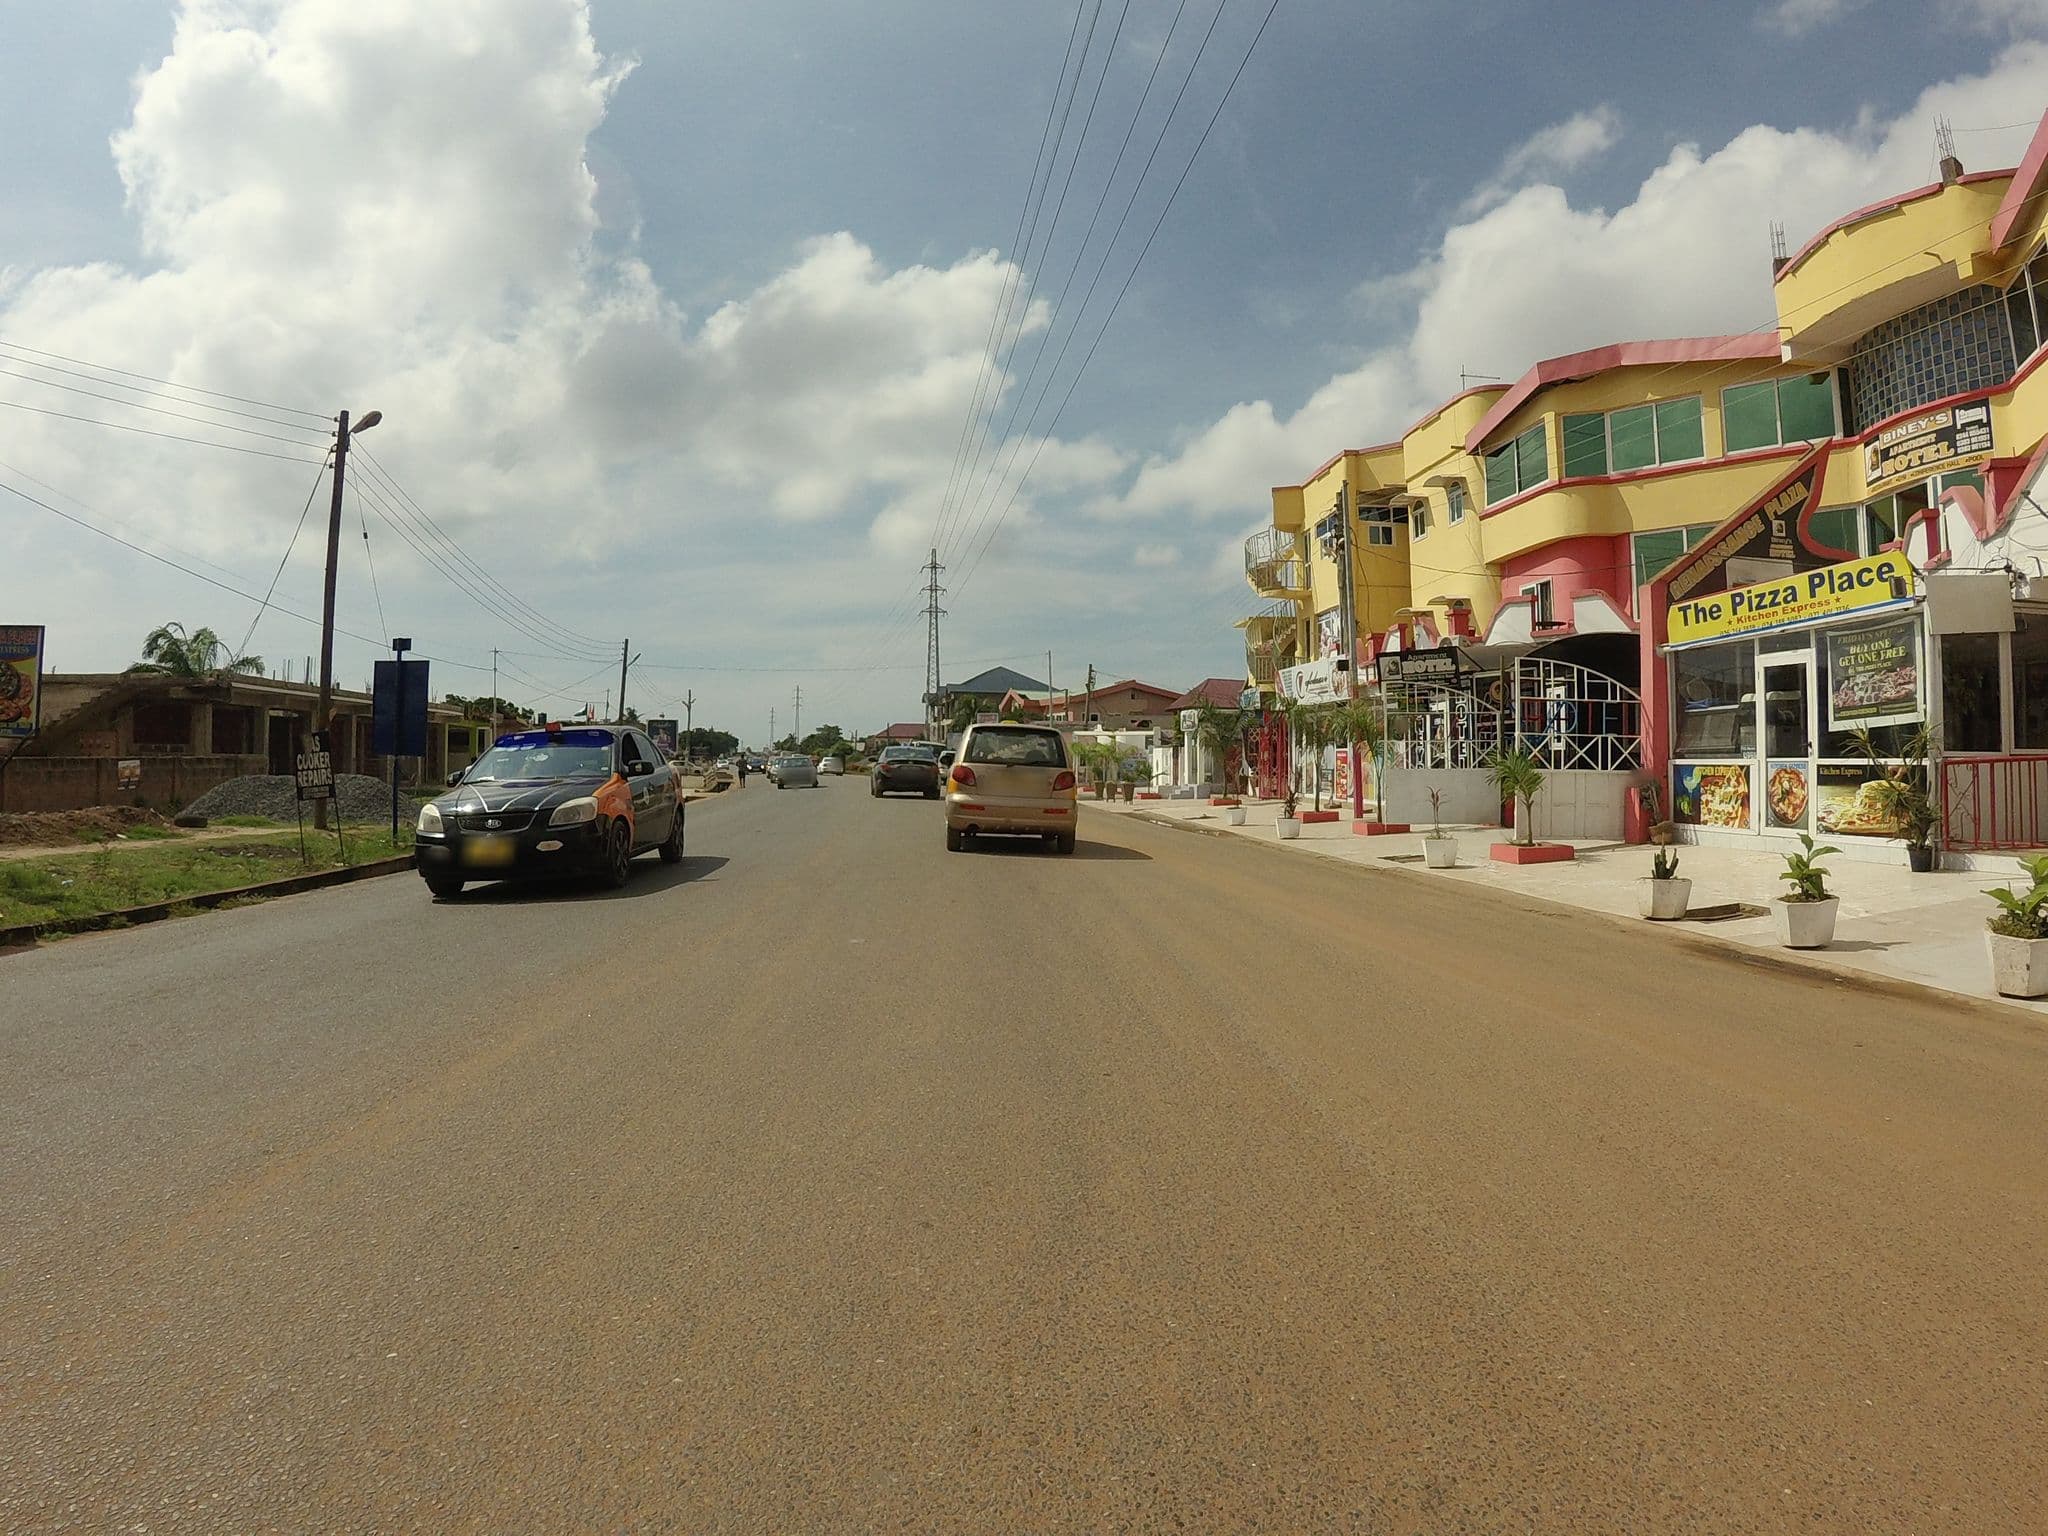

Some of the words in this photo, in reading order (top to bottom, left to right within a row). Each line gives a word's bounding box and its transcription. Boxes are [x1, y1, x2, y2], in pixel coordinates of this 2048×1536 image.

[1883, 412, 1948, 443] BINEY'S
[1882, 442, 1955, 477] HOTEL
[1669, 514, 1766, 600] RENAISSANCE
[1764, 481, 1810, 520] PLAZA
[1677, 602, 1722, 627] The
[1730, 585, 1798, 616] Pizza
[1808, 562, 1895, 599] Place
[1736, 610, 1779, 624] Kitchen
[1782, 599, 1831, 615] Express
[1839, 655, 1856, 667] GET
[1858, 651, 1878, 664] ONE
[1880, 646, 1906, 660] FREE
[1850, 643, 1868, 655] BUY
[1870, 638, 1891, 651] ONE
[1402, 658, 1456, 674] HOTEL
[296, 751, 331, 770] COOKER
[296, 768, 333, 787] REPAIRS
